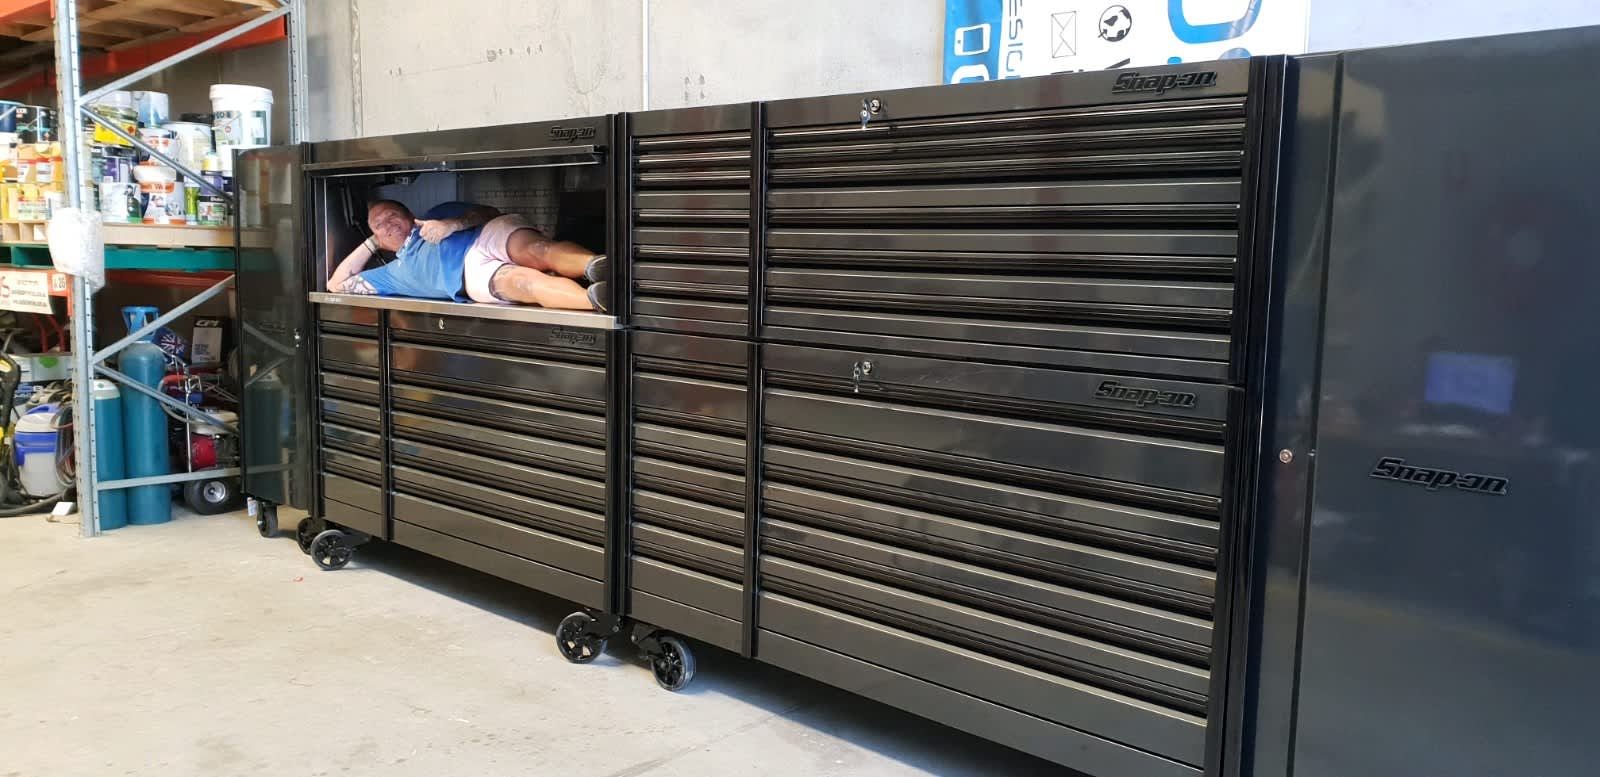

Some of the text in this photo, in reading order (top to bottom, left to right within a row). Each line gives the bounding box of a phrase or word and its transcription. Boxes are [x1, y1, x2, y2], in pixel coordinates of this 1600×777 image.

[1111, 71, 1218, 95] Snap-on
[1094, 380, 1197, 408] Snap-on
[1369, 456, 1510, 496] Snap-on
